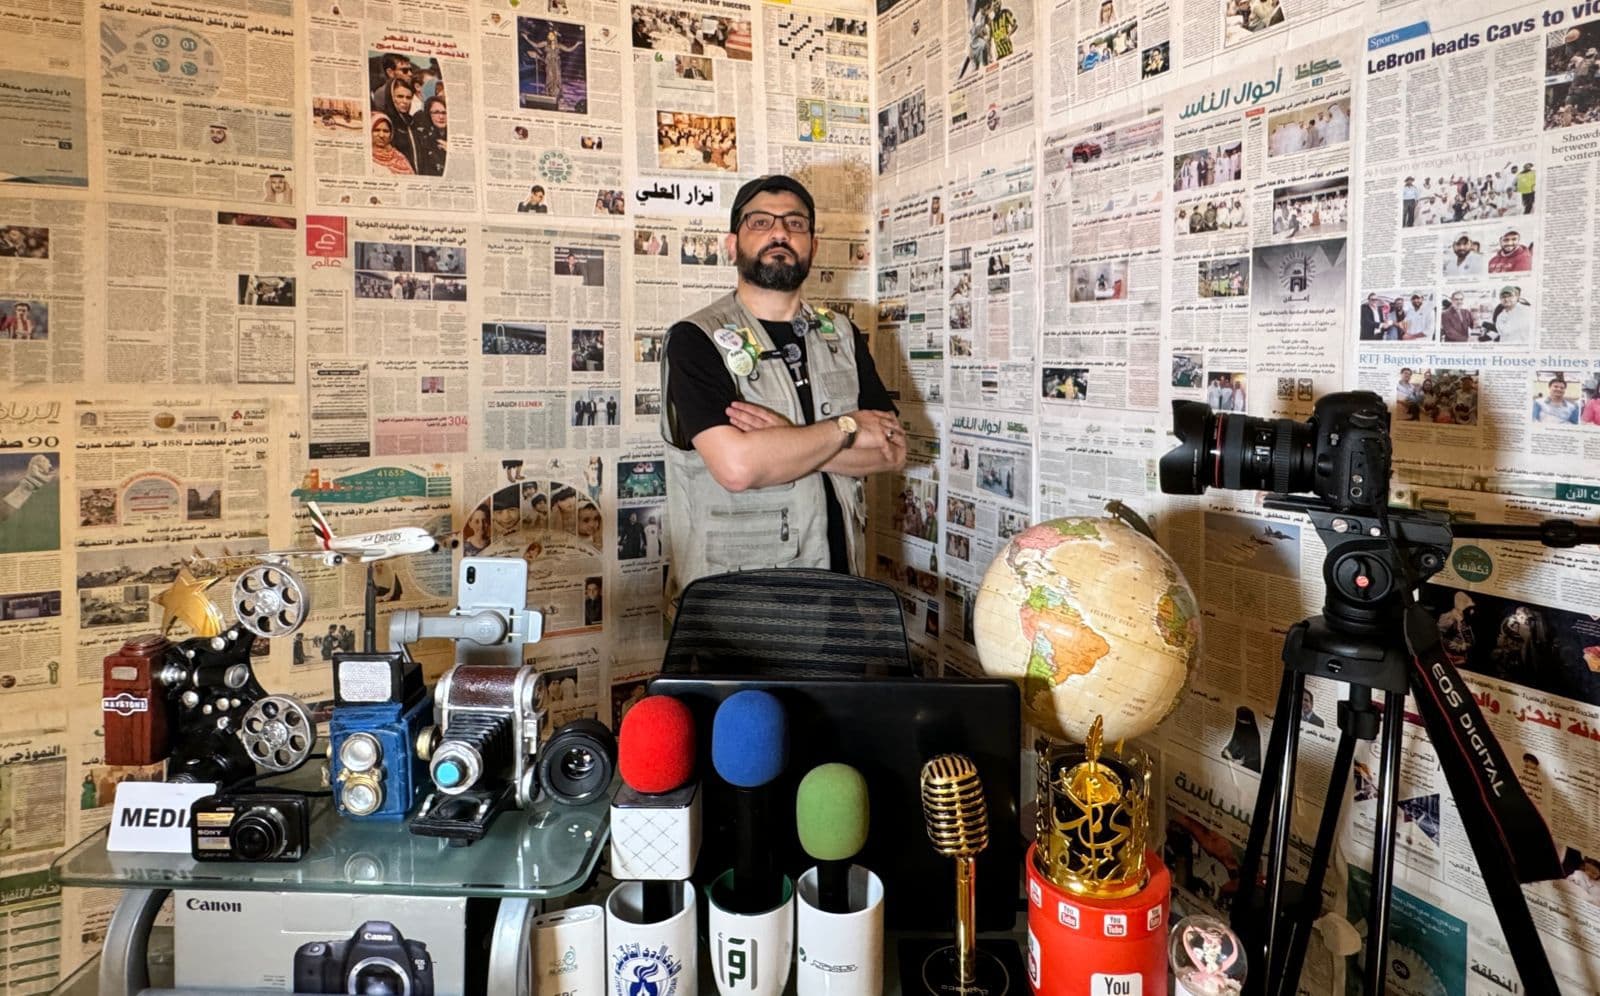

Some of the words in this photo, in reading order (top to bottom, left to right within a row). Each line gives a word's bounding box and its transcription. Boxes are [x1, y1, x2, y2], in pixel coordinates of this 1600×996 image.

[722, 0, 752, 10] success
[1367, 48, 1426, 75] LeBron
[1432, 33, 1480, 57] leads
[1486, 17, 1536, 42] Cavs
[1543, 8, 1564, 27] to
[1370, 31, 1399, 49] Sports
[1295, 58, 1342, 81] عكاظ
[1233, 67, 1283, 105] أحوال
[1179, 87, 1231, 120] الناس
[1483, 143, 1537, 160] champion
[1551, 141, 1598, 154] between
[635, 182, 680, 206] العلي
[687, 185, 714, 204] نزار
[1359, 353, 1379, 366] RTJ
[1383, 353, 1423, 367] Baguio
[1428, 354, 1487, 367] Transient
[1492, 354, 1536, 367] House
[1541, 355, 1589, 368] shines
[952, 416, 977, 431] الناس
[27, 436, 60, 448] 90
[249, 436, 269, 444] 900
[1457, 561, 1489, 575] تكشف
[1431, 662, 1464, 708] EOS
[1460, 712, 1504, 798] DIGITAL
[186, 898, 242, 912] Canon
[364, 932, 393, 942] Canon
[1470, 958, 1518, 994] المنطقة
[1104, 976, 1130, 996] You
